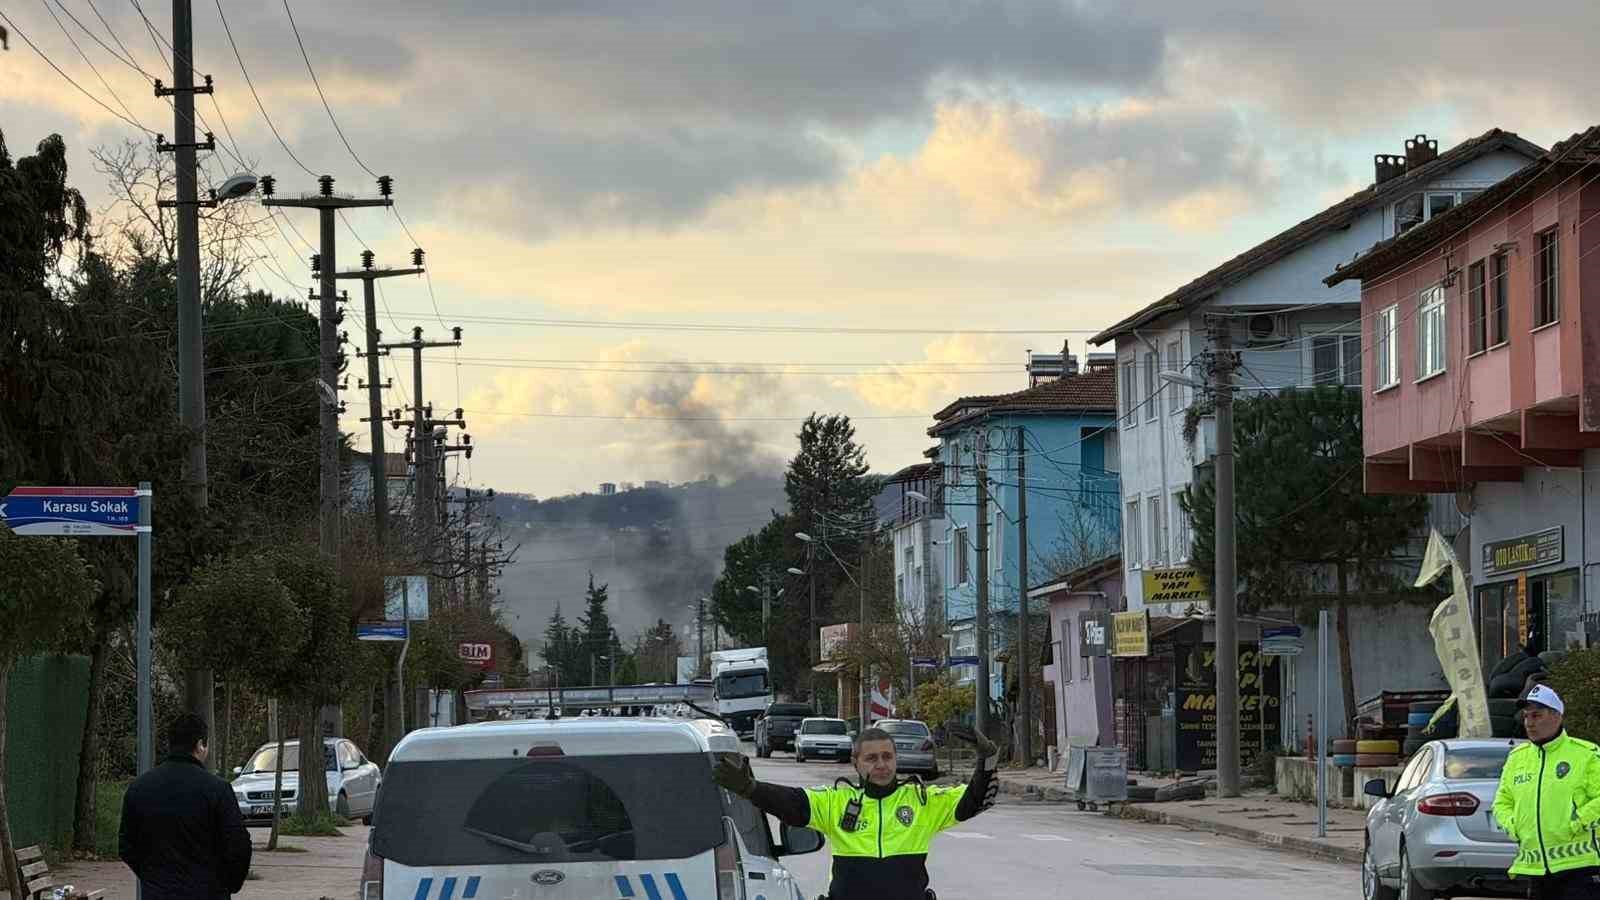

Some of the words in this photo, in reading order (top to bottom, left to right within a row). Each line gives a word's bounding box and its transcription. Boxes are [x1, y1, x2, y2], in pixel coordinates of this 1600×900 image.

[43, 500, 87, 513] Karasu
[90, 500, 128, 513] Sokak
[1154, 570, 1195, 581] YALÇIN
[1161, 581, 1190, 590] YAPI
[1152, 590, 1200, 600] MARKET
